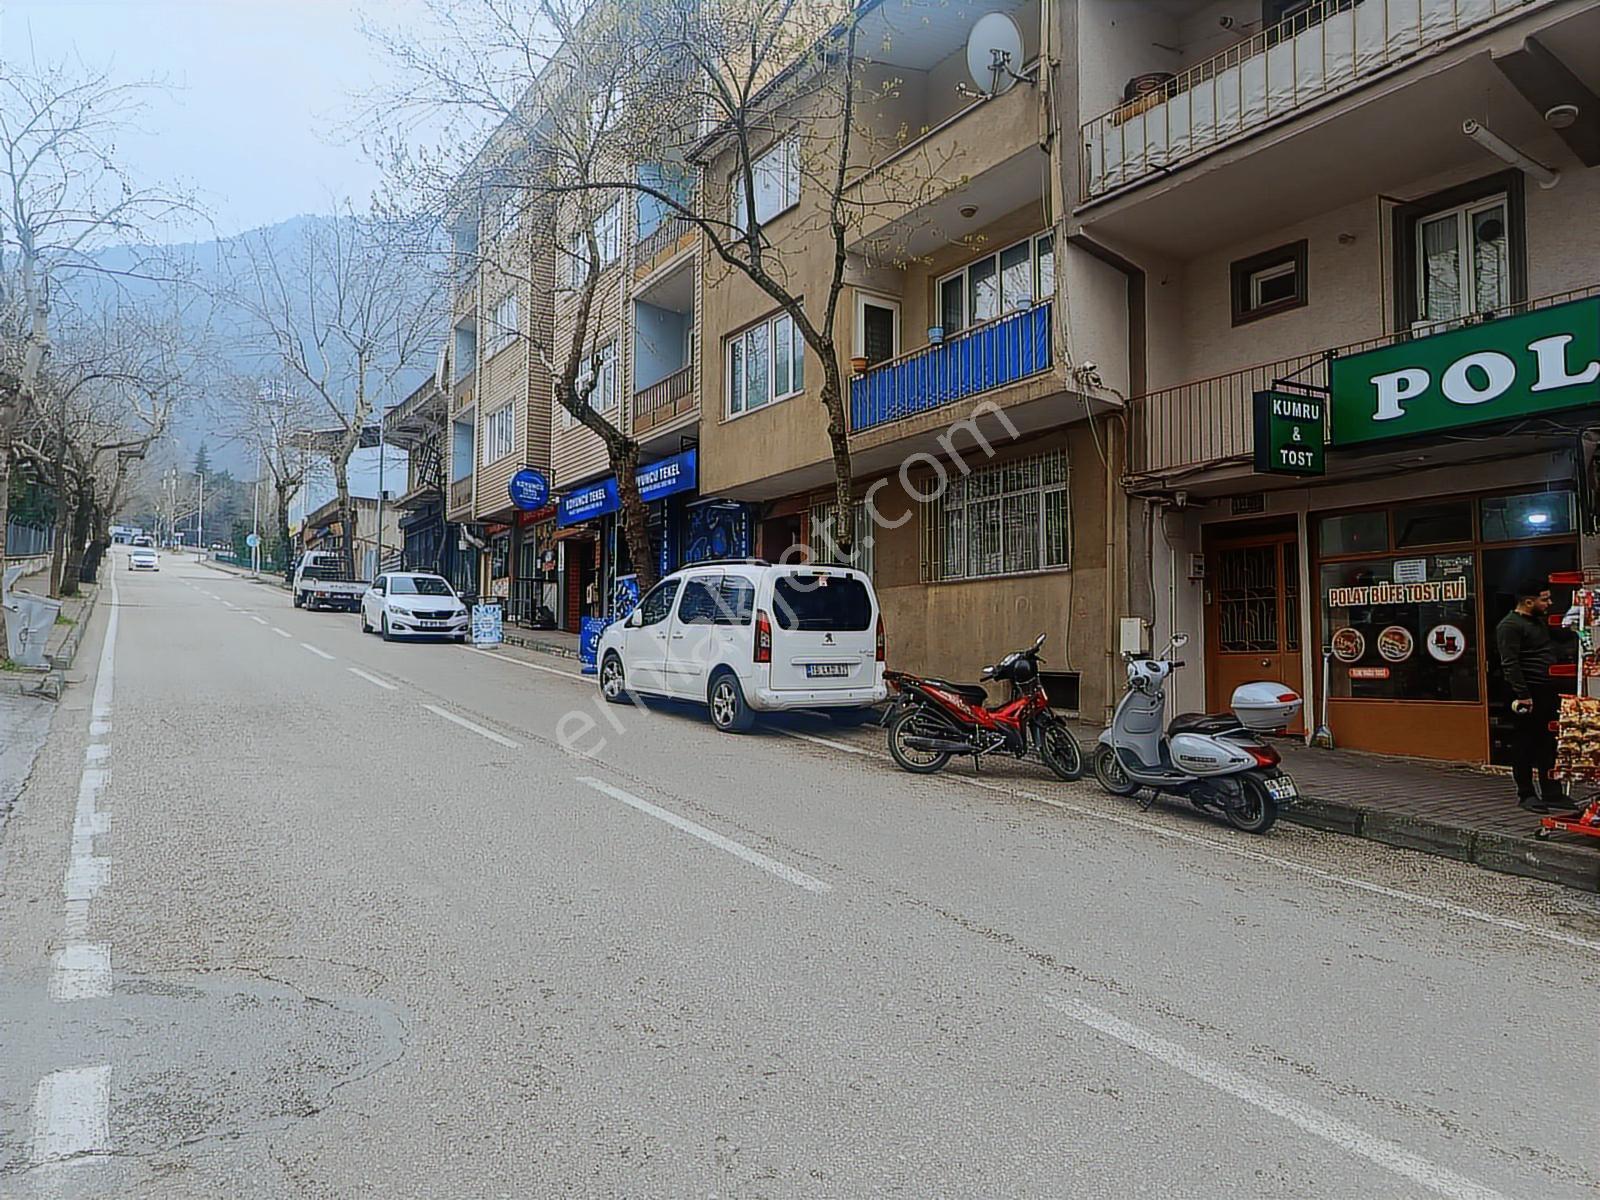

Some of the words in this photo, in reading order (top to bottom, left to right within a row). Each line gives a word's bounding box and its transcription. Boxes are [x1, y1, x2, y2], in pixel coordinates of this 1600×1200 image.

[1369, 334, 1600, 421] POL
[1272, 398, 1321, 421] KUMRU
[1292, 426, 1302, 442] &
[1280, 448, 1314, 468] TOST
[635, 470, 659, 487] YUNCU
[659, 463, 681, 480] TEKEL
[589, 488, 606, 502] TEKEL
[1329, 586, 1369, 607] POLAT
[1370, 580, 1404, 605] BÜFE
[1405, 582, 1440, 603] TOST
[1442, 576, 1467, 601] EVİ
